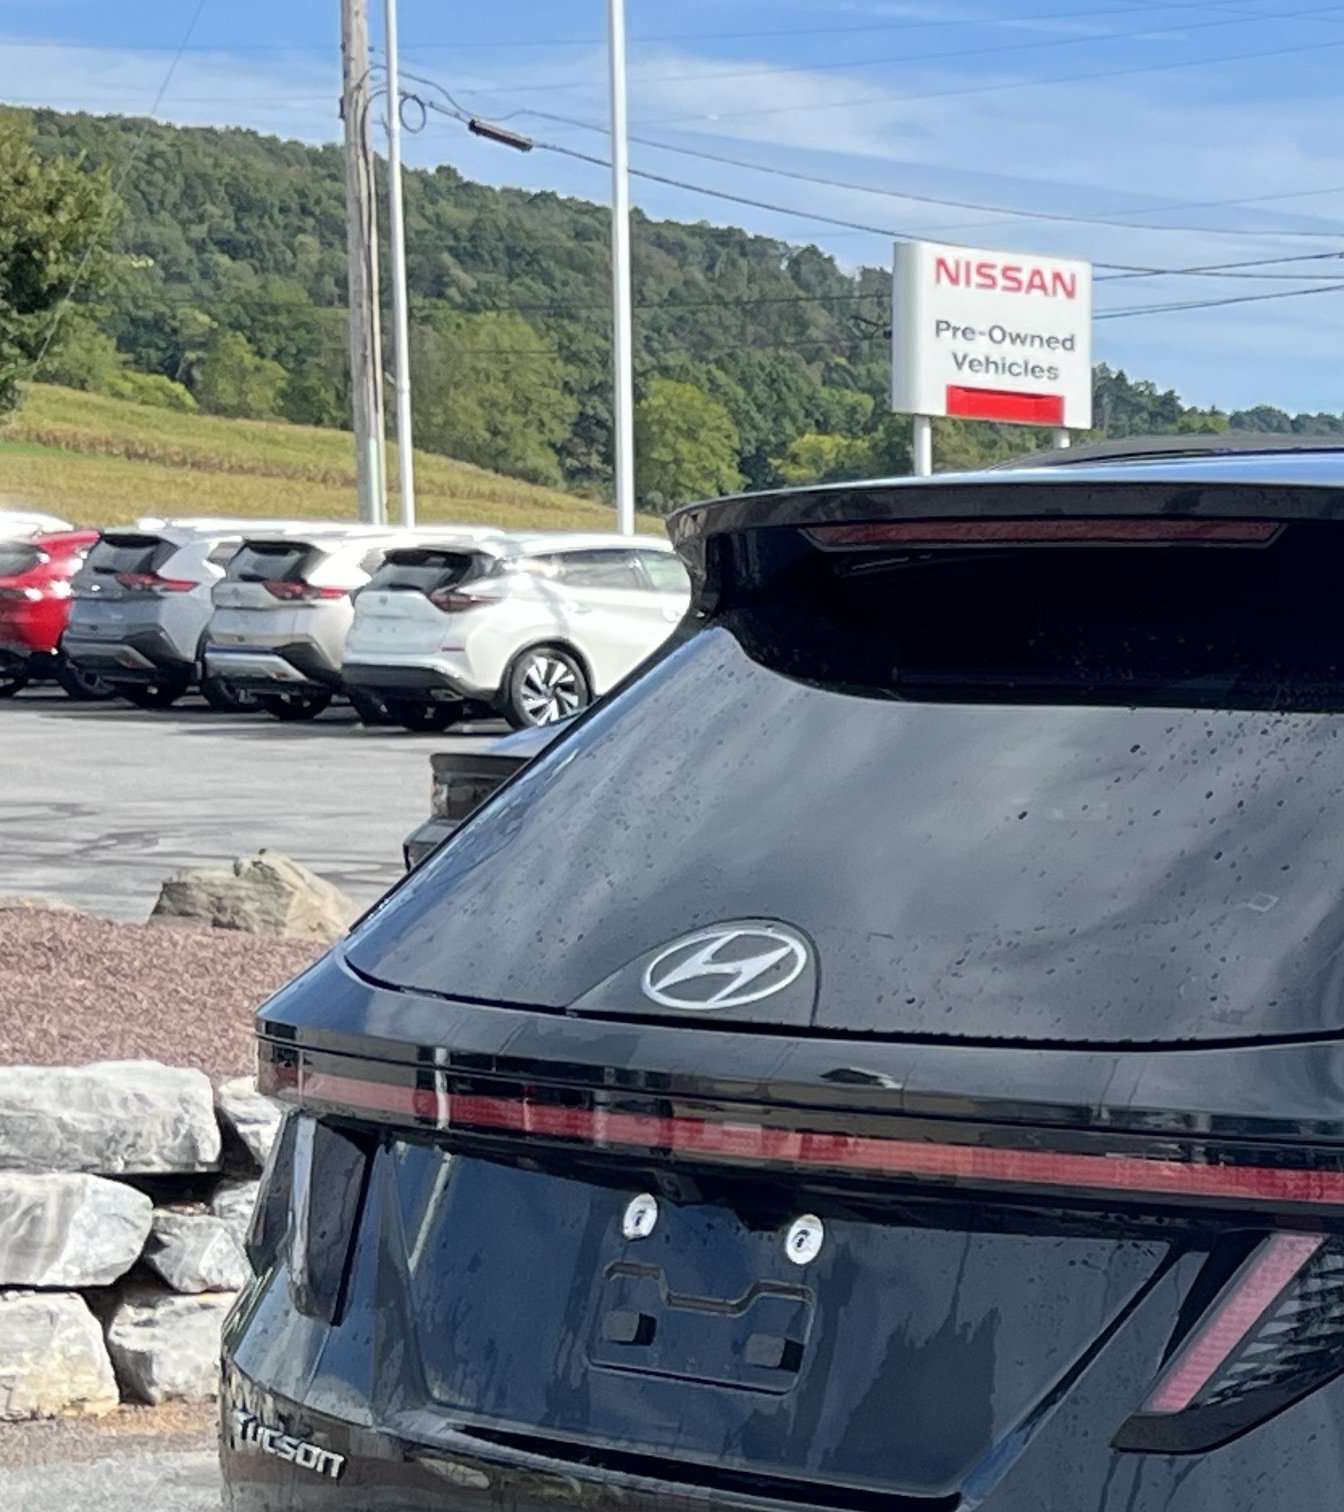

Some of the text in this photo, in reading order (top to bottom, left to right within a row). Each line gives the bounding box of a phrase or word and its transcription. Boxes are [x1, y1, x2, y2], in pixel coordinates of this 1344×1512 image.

[935, 257, 1076, 299] NISSAN
[935, 319, 1075, 351] Pre-Owned
[952, 351, 1059, 380] Vehicles
